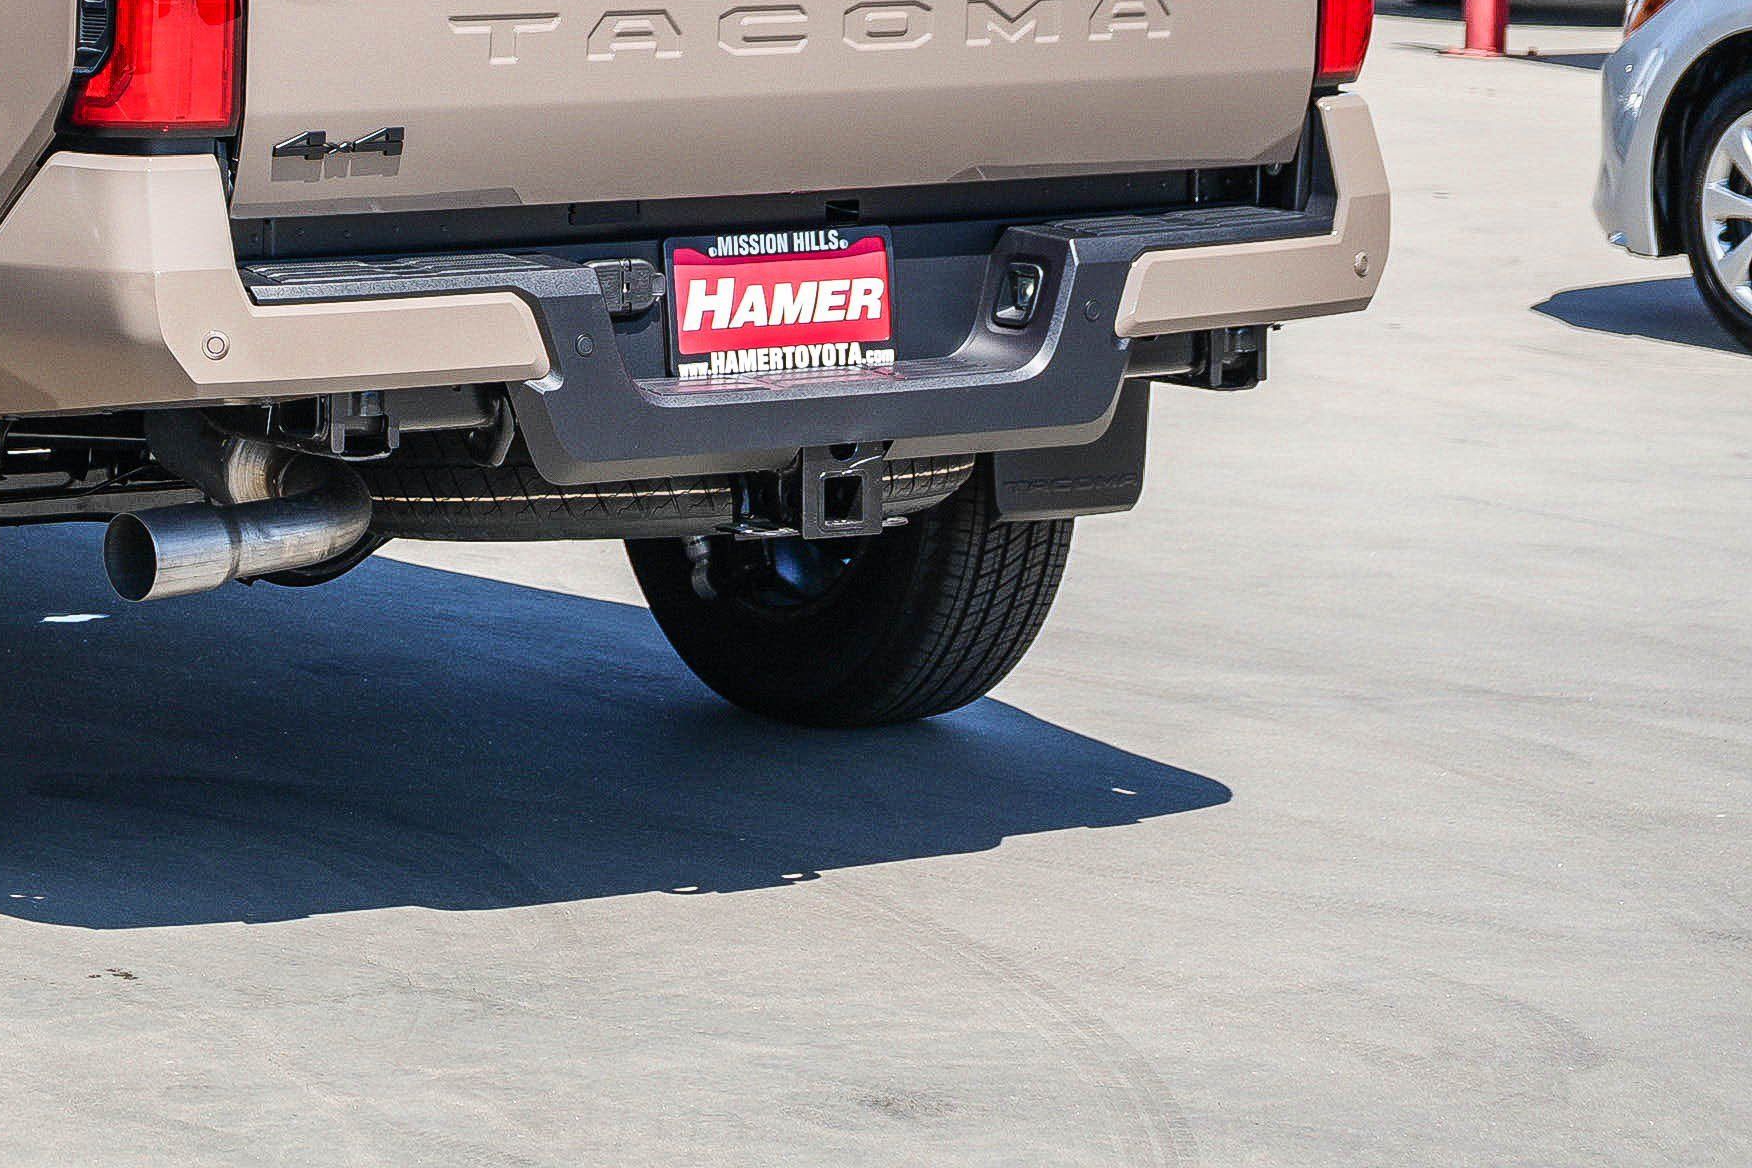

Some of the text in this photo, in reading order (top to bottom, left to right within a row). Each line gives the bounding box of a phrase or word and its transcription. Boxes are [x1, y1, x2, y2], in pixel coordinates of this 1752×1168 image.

[717, 230, 839, 257] MISSION HILLS
[681, 276, 886, 332] HAMER
[678, 342, 895, 379] www.HAMERTOYOTA.com
